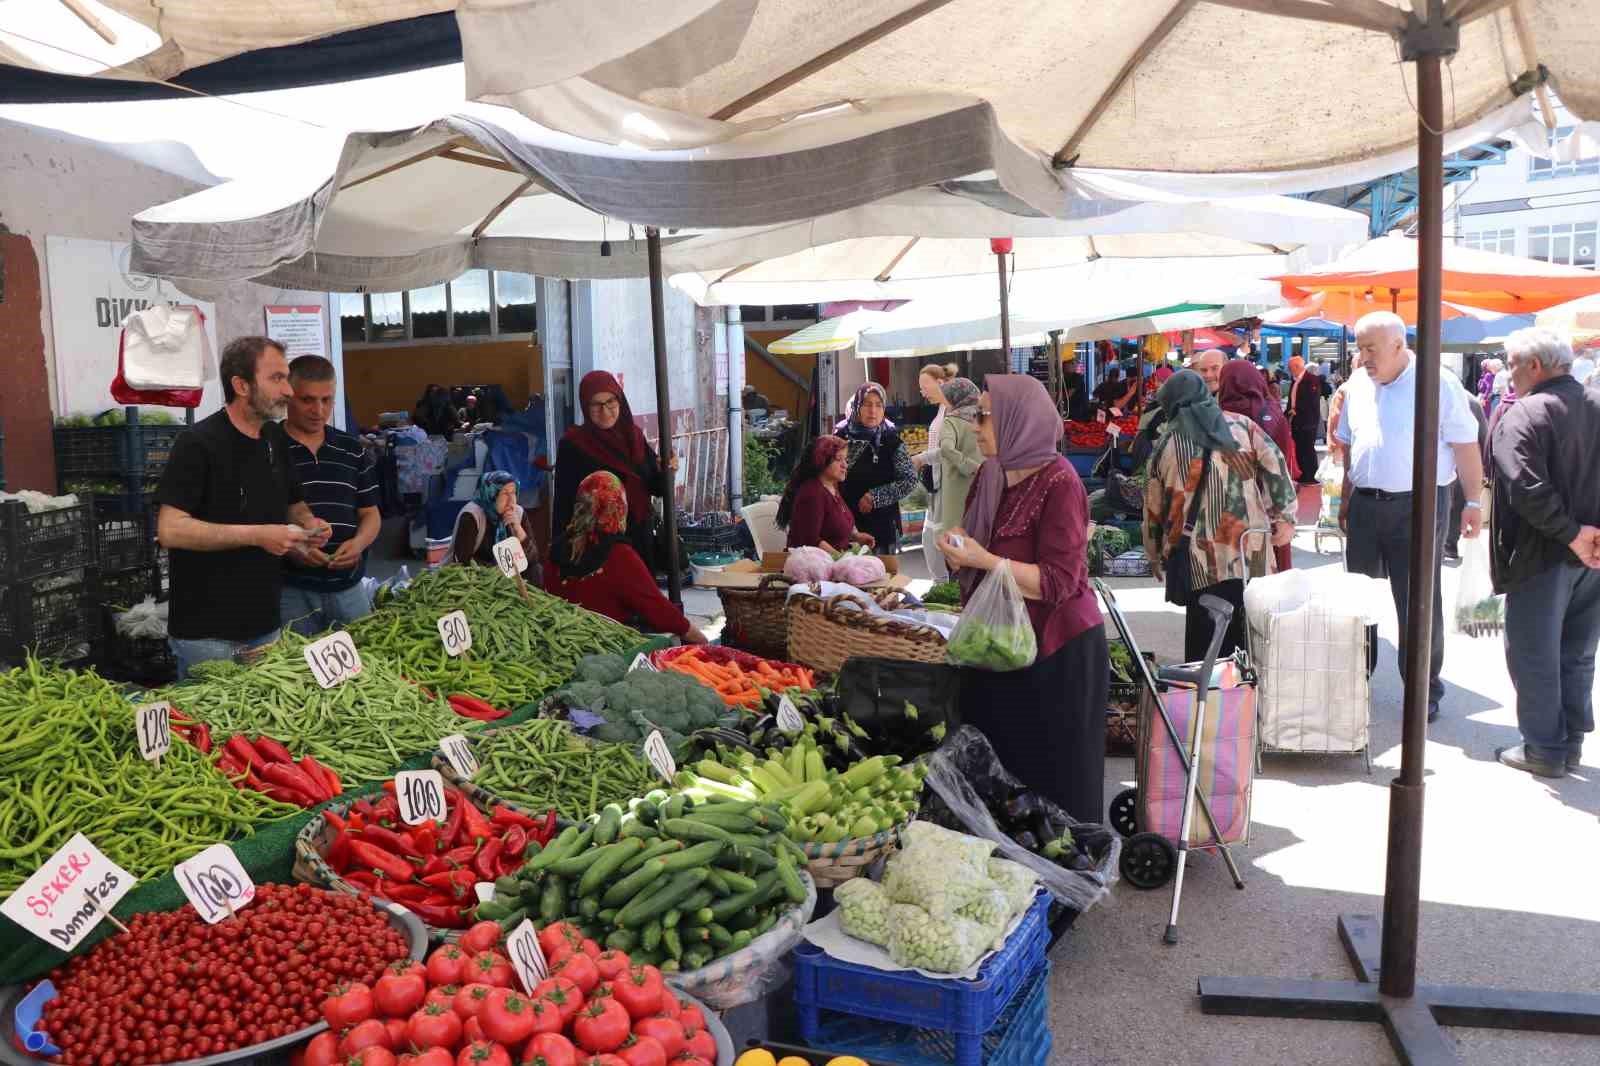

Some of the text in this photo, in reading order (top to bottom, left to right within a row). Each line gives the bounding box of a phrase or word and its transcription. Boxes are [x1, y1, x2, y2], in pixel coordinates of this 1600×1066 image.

[310, 640, 355, 685] 150
[143, 707, 169, 754] 120
[403, 776, 441, 821] 100
[26, 852, 91, 918] ŞEKER
[50, 872, 119, 945] Domates
[183, 864, 242, 919] 100
